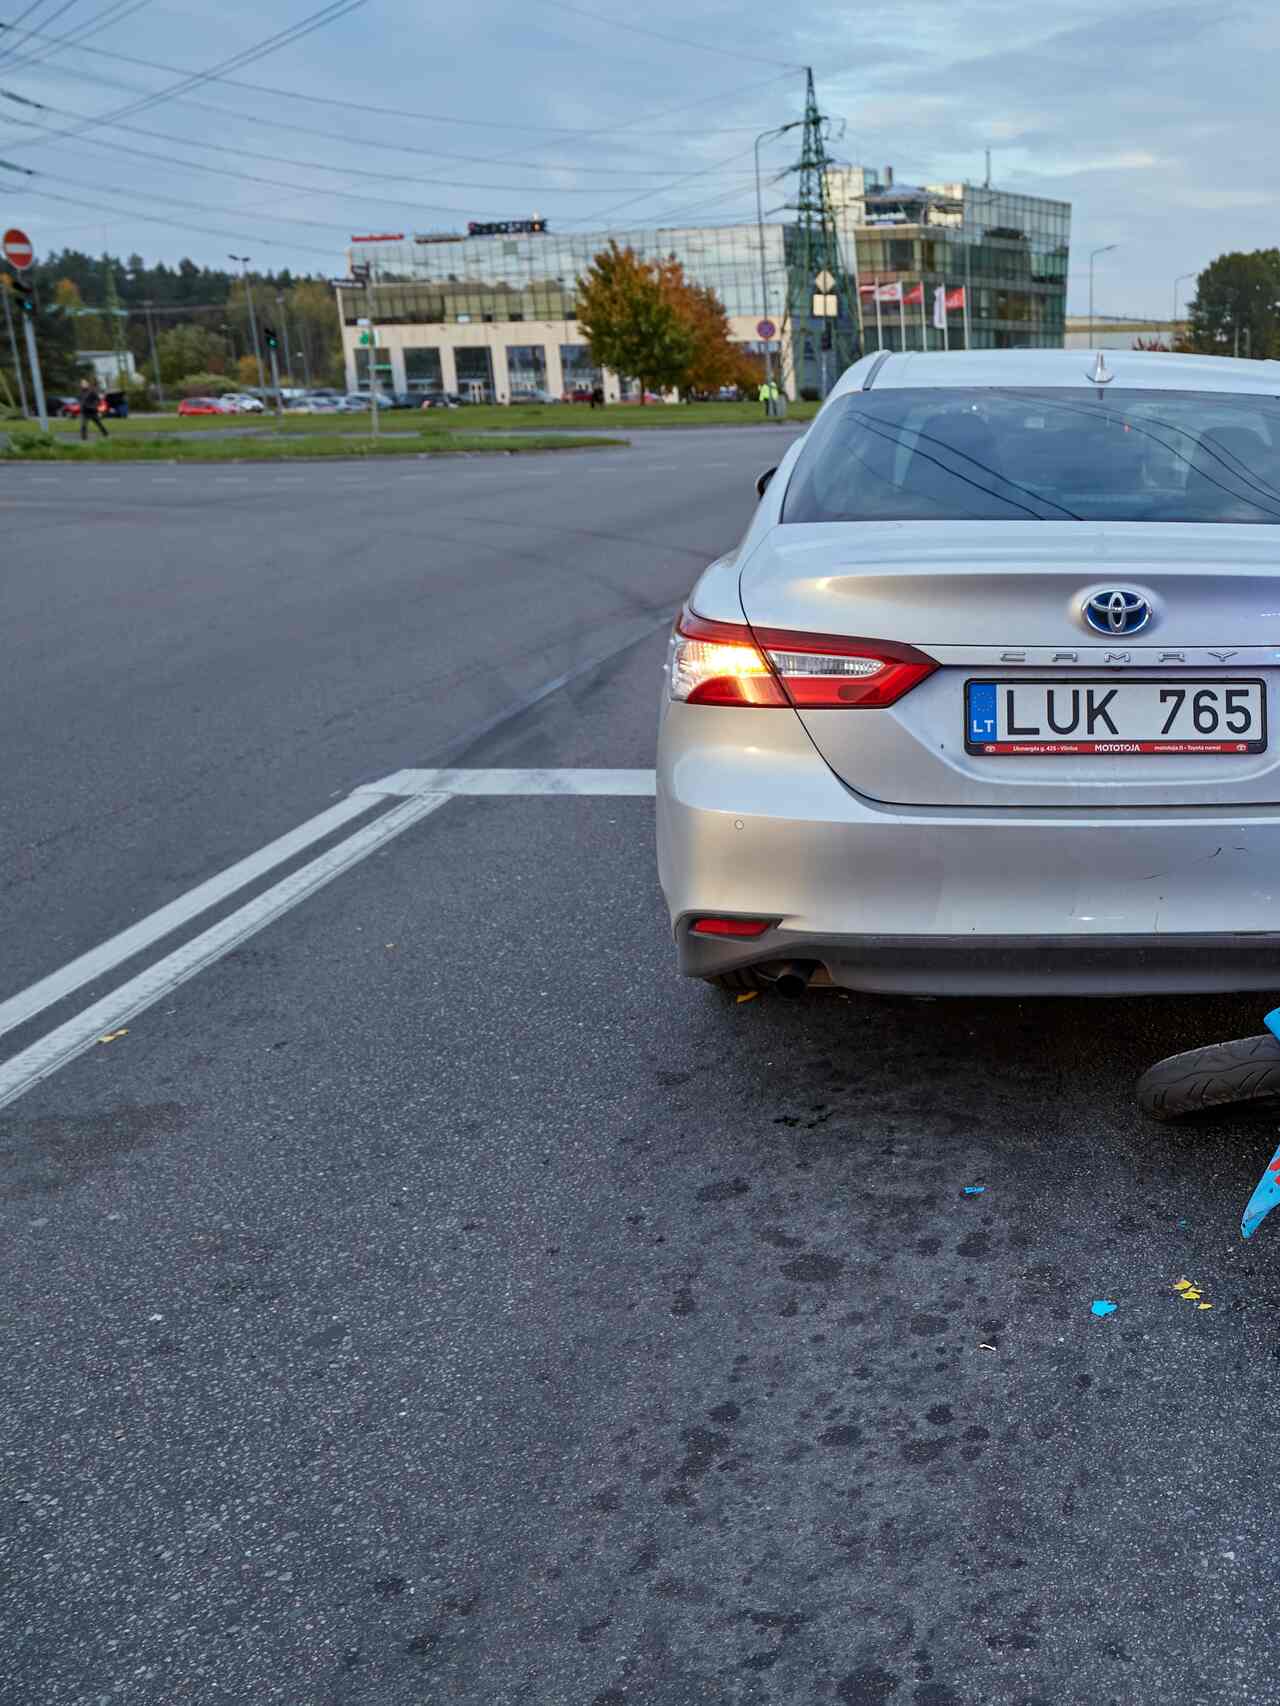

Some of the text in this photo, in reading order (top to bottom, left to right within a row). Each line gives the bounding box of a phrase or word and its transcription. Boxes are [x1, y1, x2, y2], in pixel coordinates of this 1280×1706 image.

[1000, 651, 1238, 663] CAMRY
[1006, 689, 1252, 735] LUK 765
[973, 720, 994, 733] LT
[1094, 744, 1141, 752] MOTOTOJA
